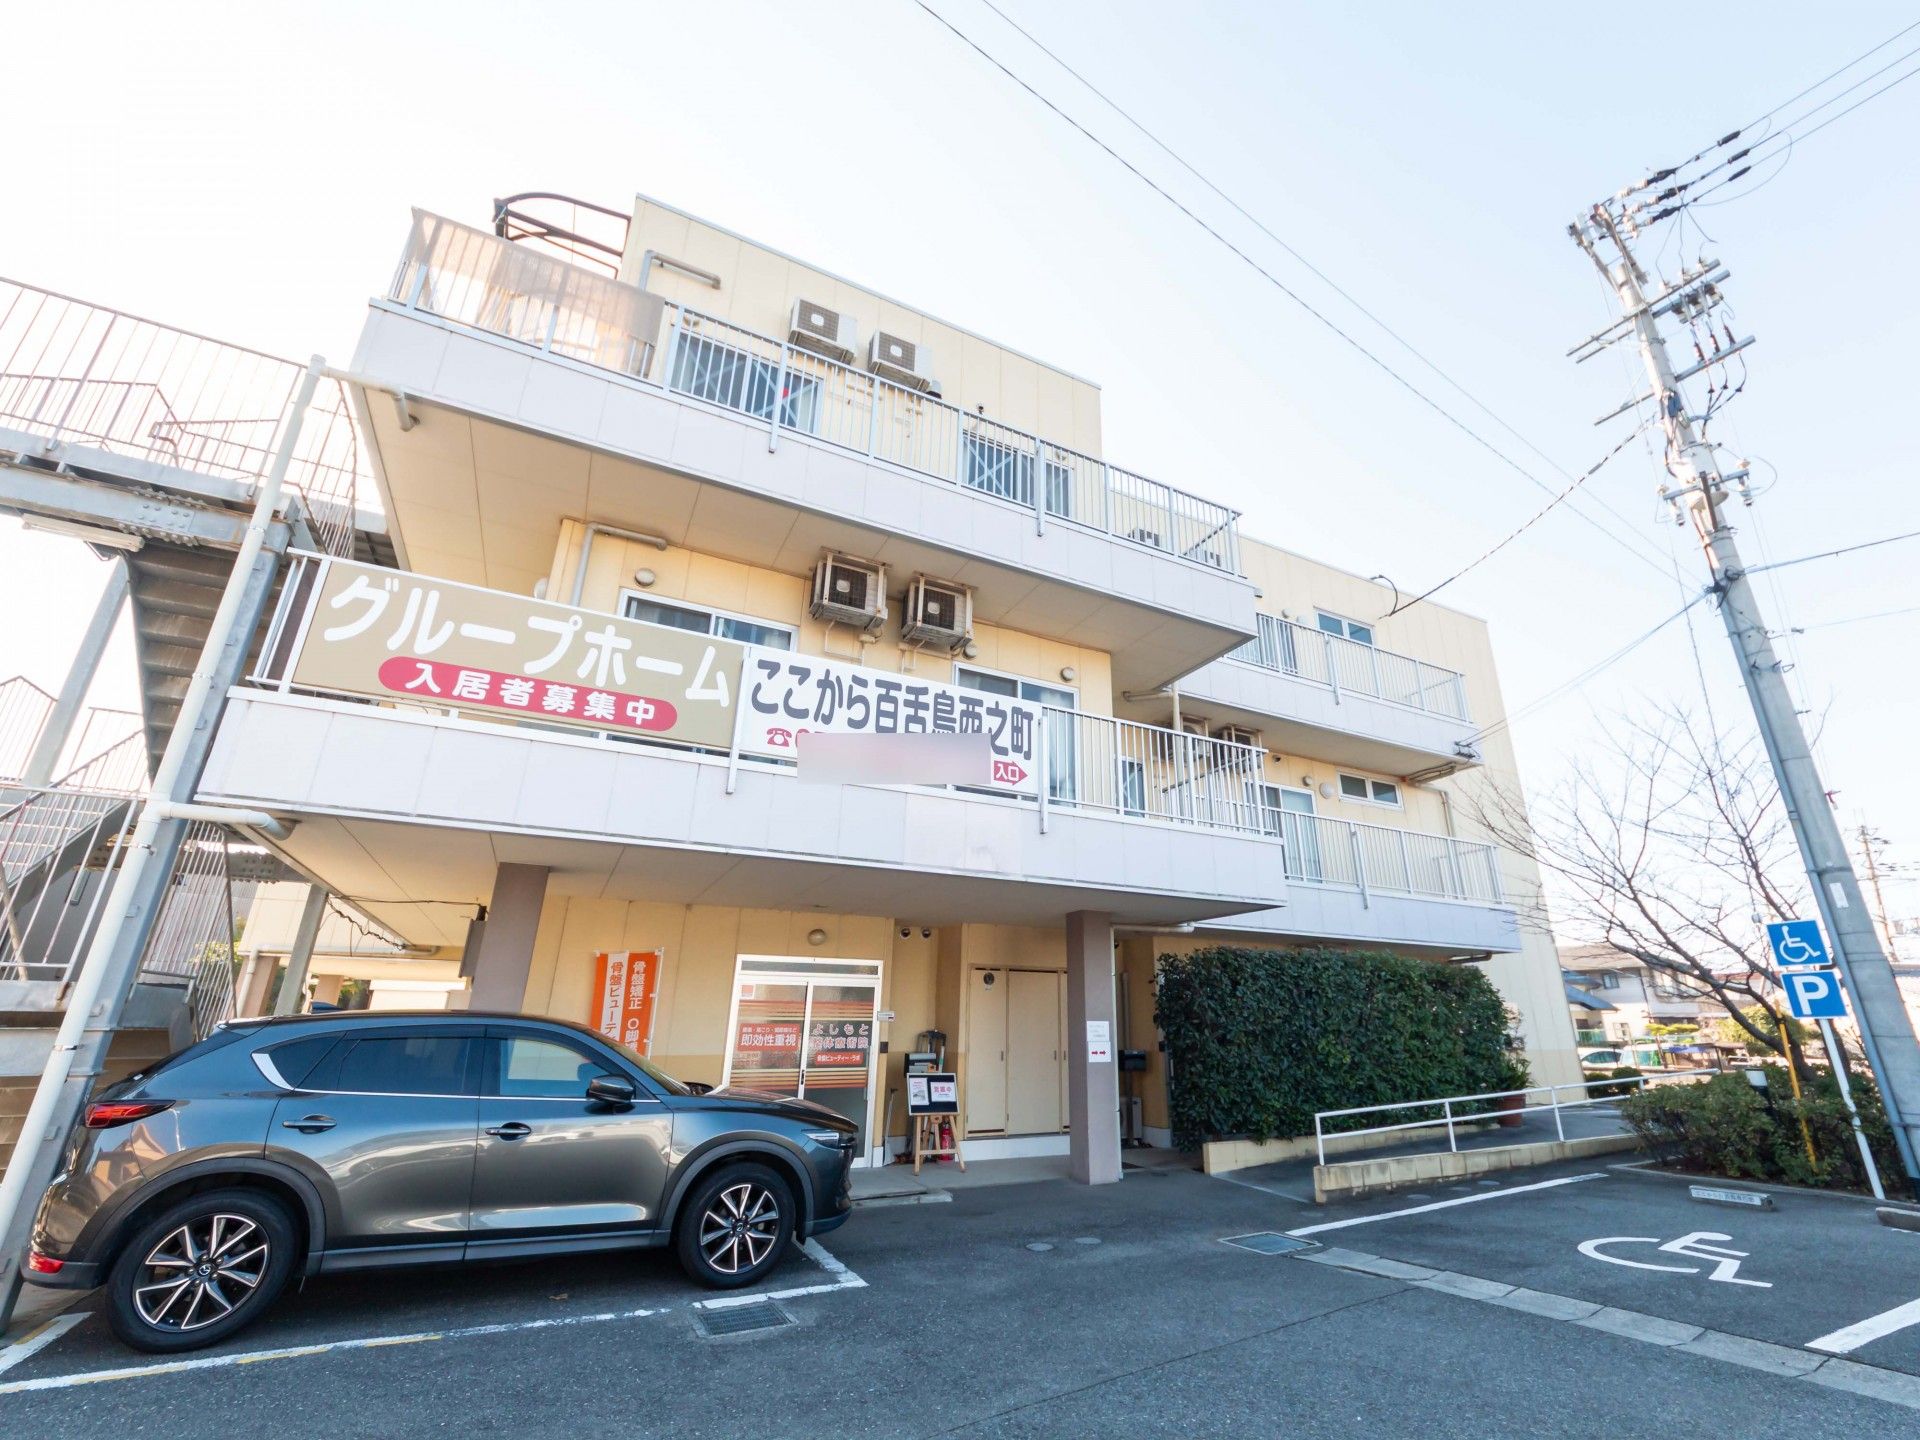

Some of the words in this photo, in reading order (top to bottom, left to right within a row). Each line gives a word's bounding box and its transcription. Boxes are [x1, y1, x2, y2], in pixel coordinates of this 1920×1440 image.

[323, 572, 730, 708] グループホーム
[404, 661, 656, 726] 入居者募集中
[751, 658, 1034, 761] ここから百舌鳥西之町
[995, 762, 1020, 781] 入口
[1792, 974, 1830, 1016] P
[740, 1033, 796, 1046] 即効性重視
[812, 1023, 869, 1036] よしもと
